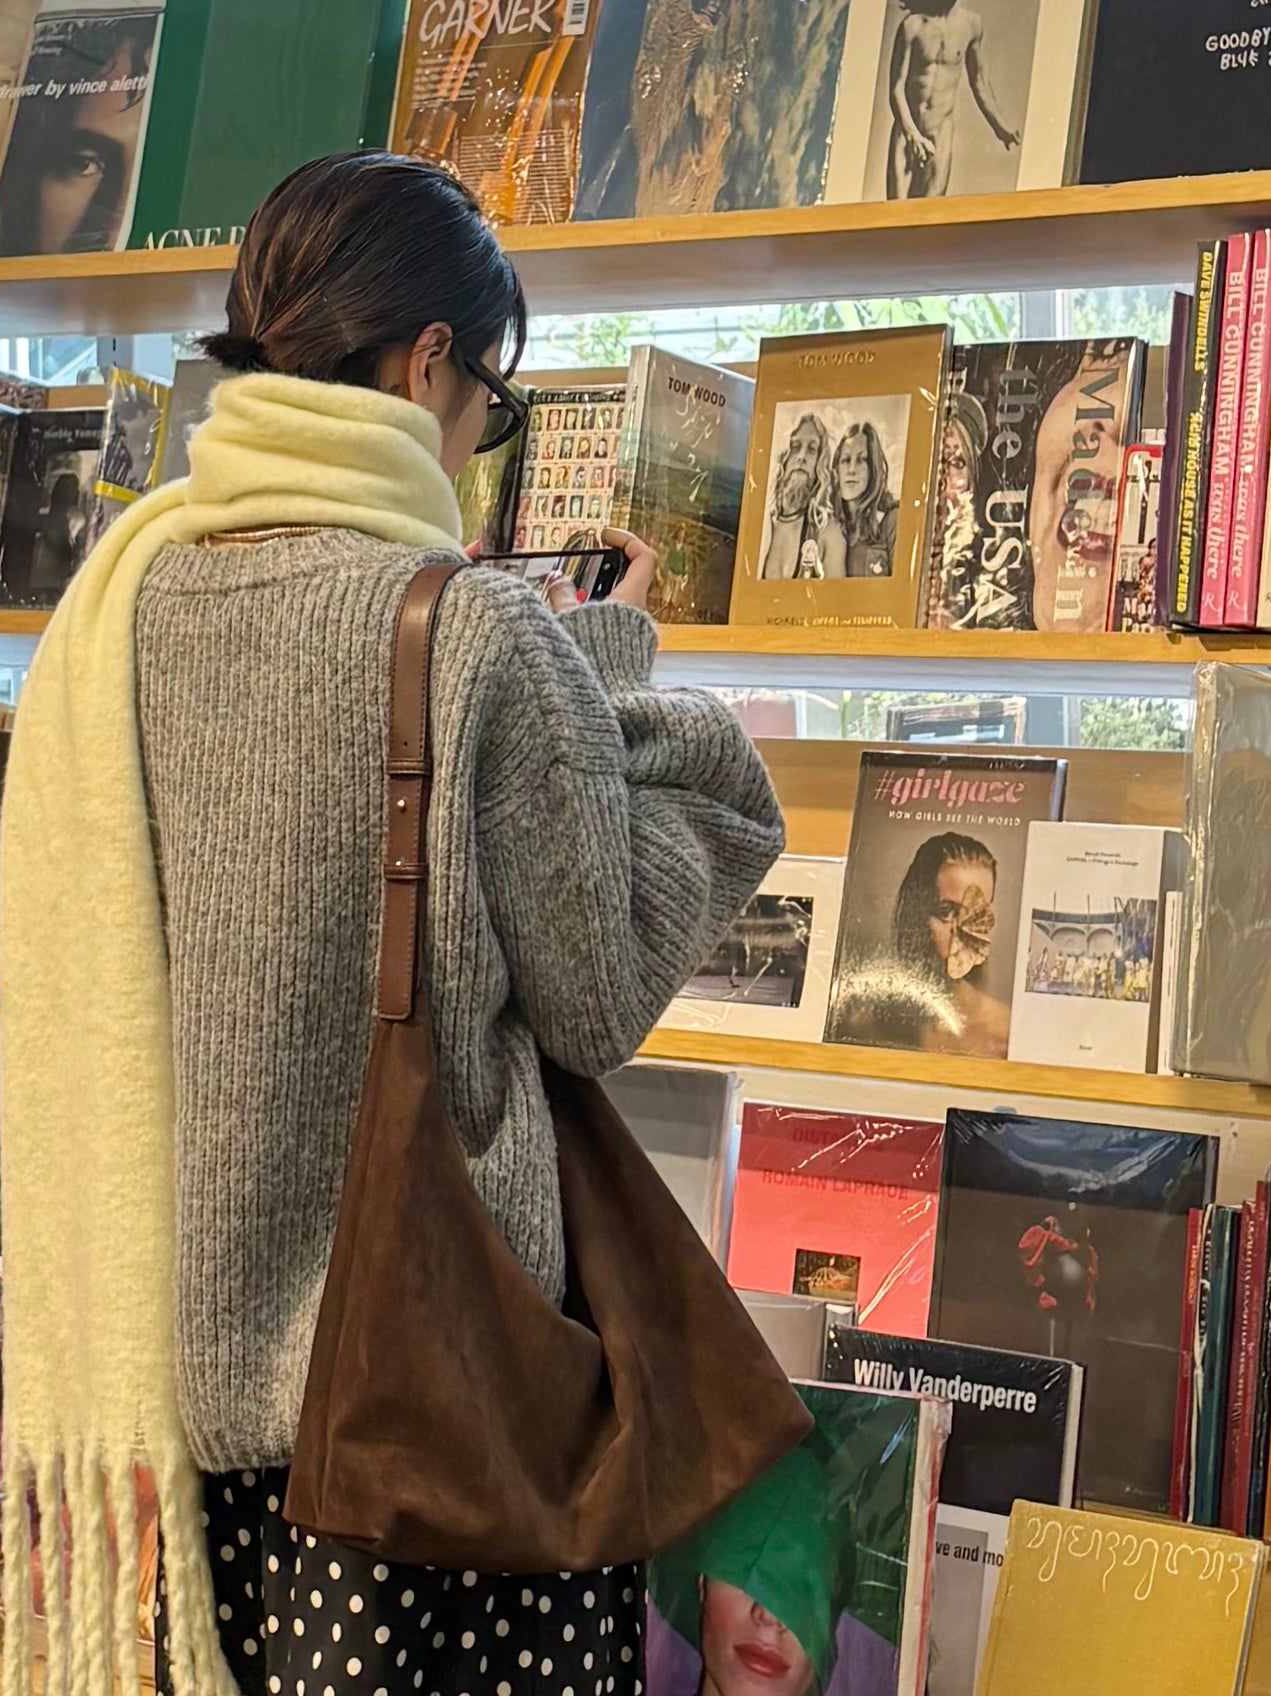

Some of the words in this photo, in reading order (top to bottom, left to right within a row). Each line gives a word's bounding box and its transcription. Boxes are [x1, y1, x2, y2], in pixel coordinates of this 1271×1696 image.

[44, 79, 66, 99] by
[69, 77, 107, 95] vince
[1200, 251, 1213, 289] DAVE
[1253, 268, 1268, 316] BILL
[1228, 271, 1243, 319] BILL
[1194, 289, 1211, 372] SWINDELLS
[668, 376, 691, 395] TOM
[693, 384, 726, 408] WOOD
[992, 369, 1040, 460] the
[1212, 325, 1240, 475] CUNNINGHAM
[1239, 321, 1264, 470] CUNNINGHAM
[1183, 448, 1200, 497] HOUSE
[1182, 499, 1196, 517] AS
[1208, 482, 1224, 521] was
[1181, 518, 1194, 534] IT
[976, 483, 1029, 624] USA
[1176, 535, 1193, 613] HAPPENED
[1206, 527, 1226, 580] there
[1232, 524, 1250, 577] there
[874, 767, 1026, 809] #girlgaze
[889, 810, 912, 821] HOW
[915, 811, 942, 822] GIRLS
[965, 814, 983, 825] THE
[987, 816, 1021, 827] WORLD
[762, 1169, 827, 1191] ROMAIN
[853, 1358, 905, 1392] Willy
[910, 1367, 1038, 1414] Vanderperre
[954, 1542, 980, 1562] and
